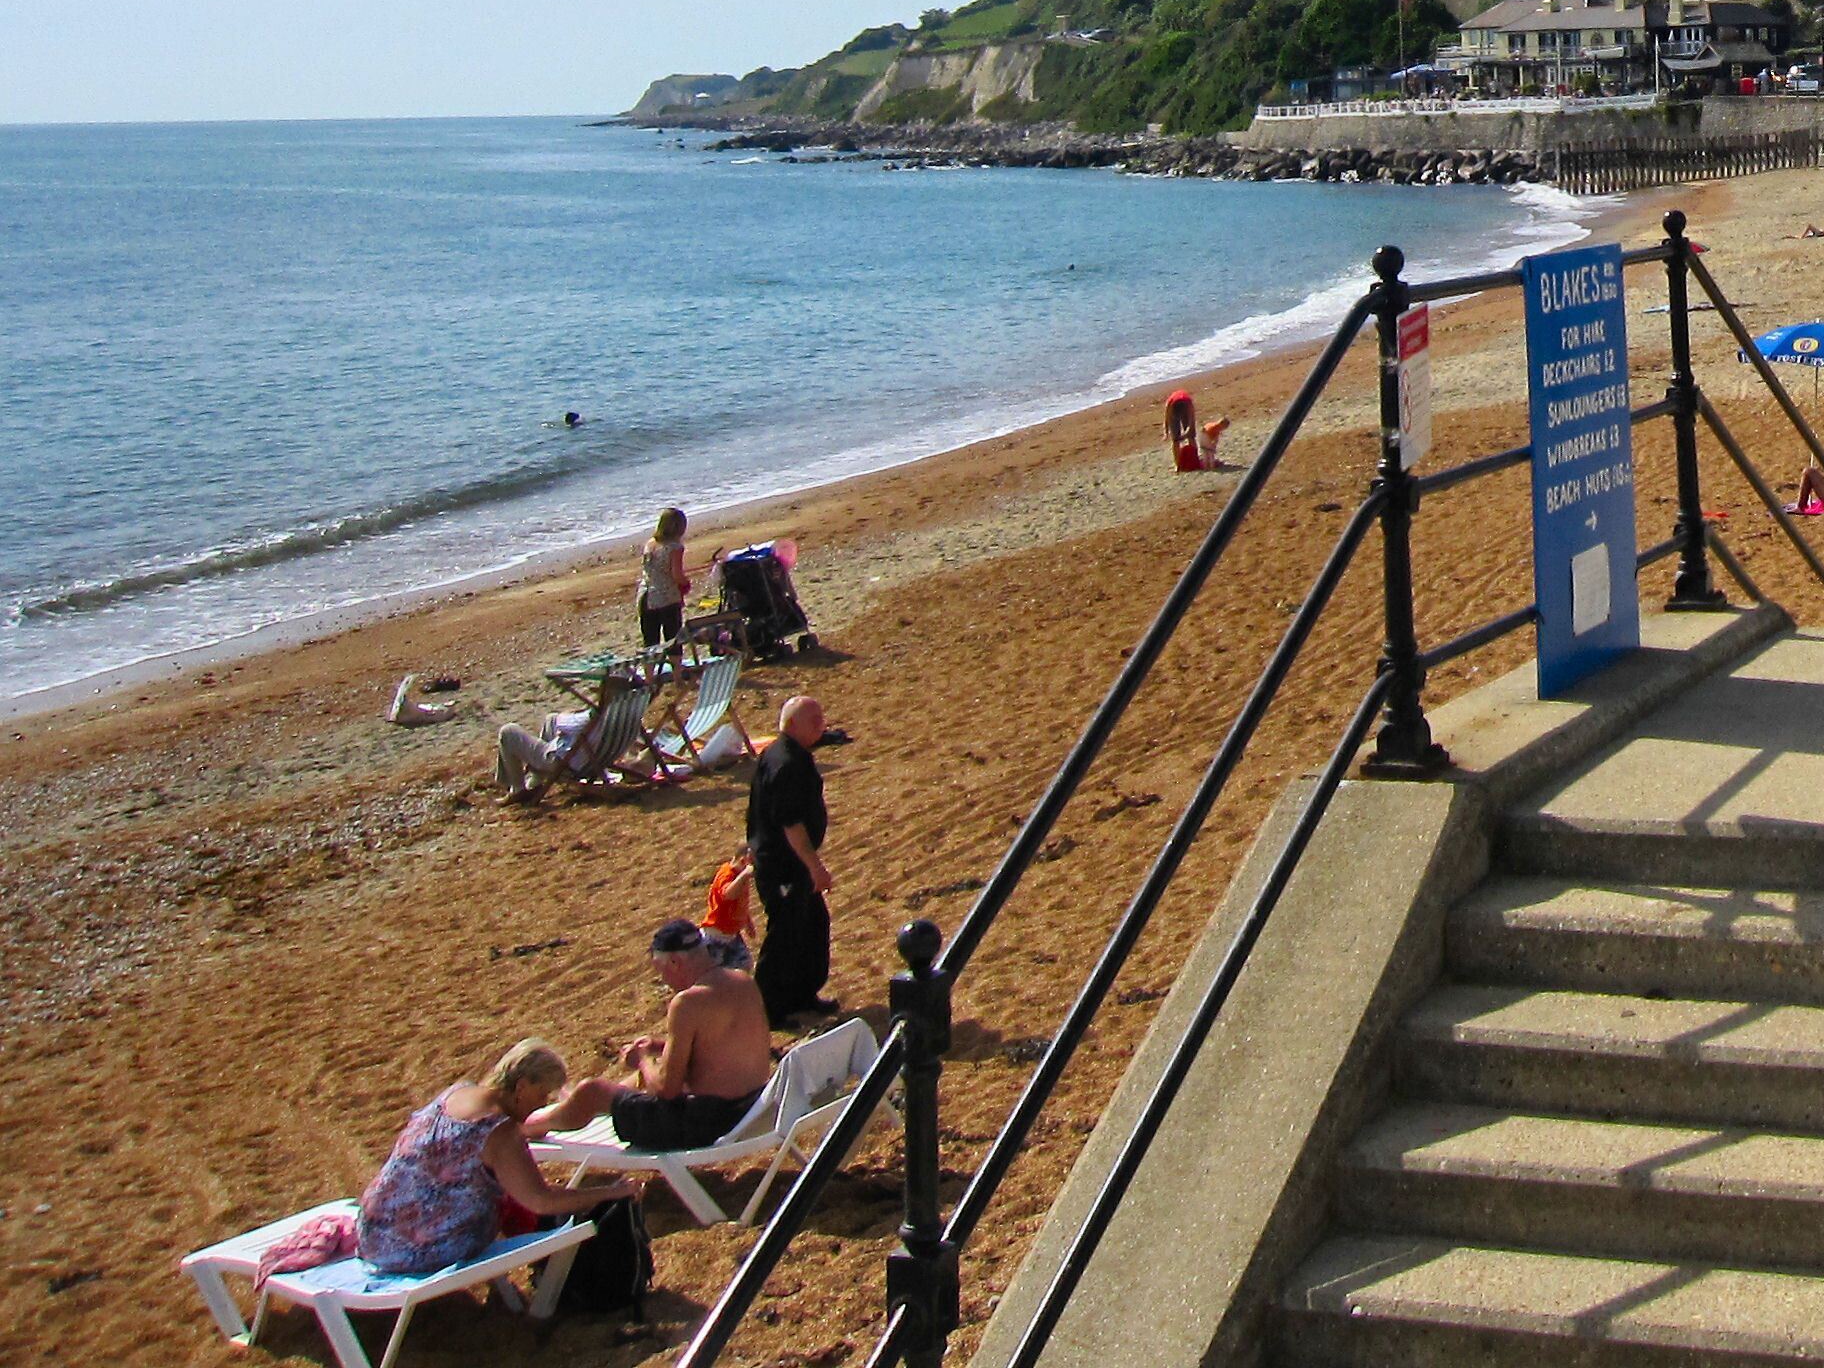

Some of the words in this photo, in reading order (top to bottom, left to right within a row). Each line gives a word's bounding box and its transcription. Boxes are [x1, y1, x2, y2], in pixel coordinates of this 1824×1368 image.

[1541, 264, 1600, 313] BLAKES
[1561, 325, 1580, 350] FOR
[1583, 319, 1605, 344] HIRE
[1543, 353, 1600, 388] DECKCHAIRS
[1547, 384, 1616, 428] SUNLOUNGERS
[1547, 428, 1606, 468] WINDBREAKS
[1546, 480, 1580, 514] BEACH
[1585, 468, 1610, 495] HUTS
